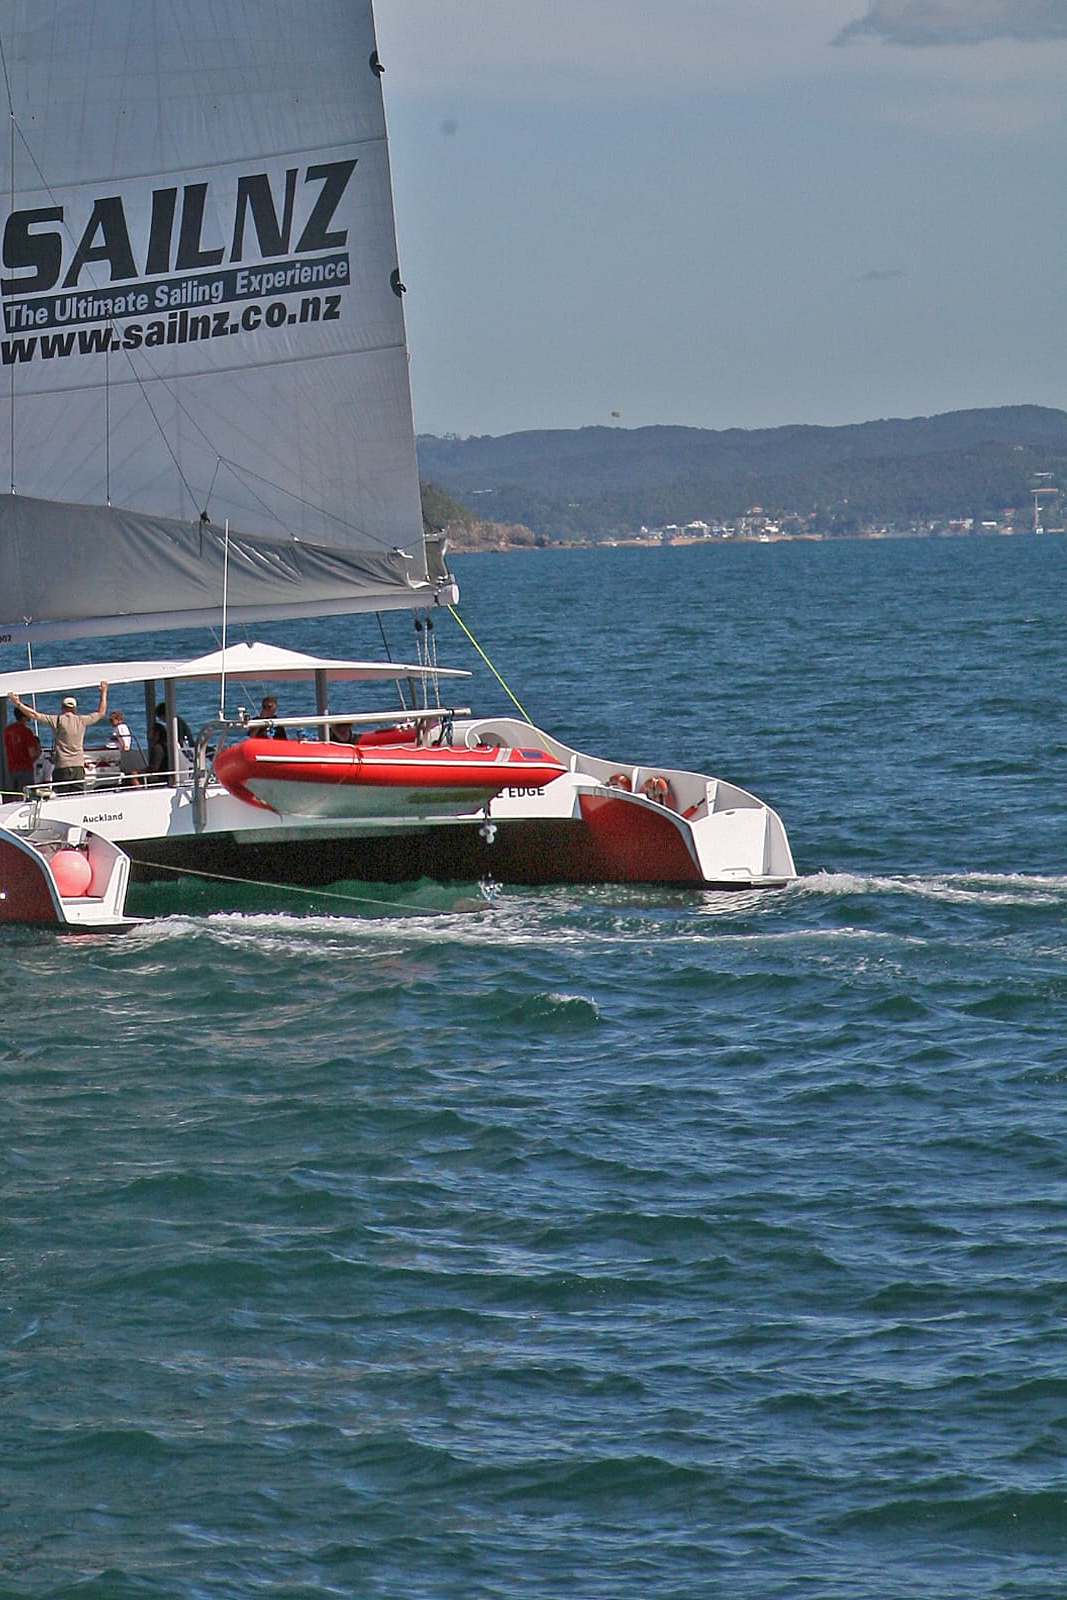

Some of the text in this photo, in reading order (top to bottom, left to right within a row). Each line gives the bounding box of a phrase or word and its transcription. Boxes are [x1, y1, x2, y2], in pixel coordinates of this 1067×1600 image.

[5, 259, 349, 328] The Ultimate Sailing Experience
[0, 295, 341, 365] www.sailnz.co.nz
[509, 786, 545, 798] EDGE
[83, 811, 123, 823] Auckland
